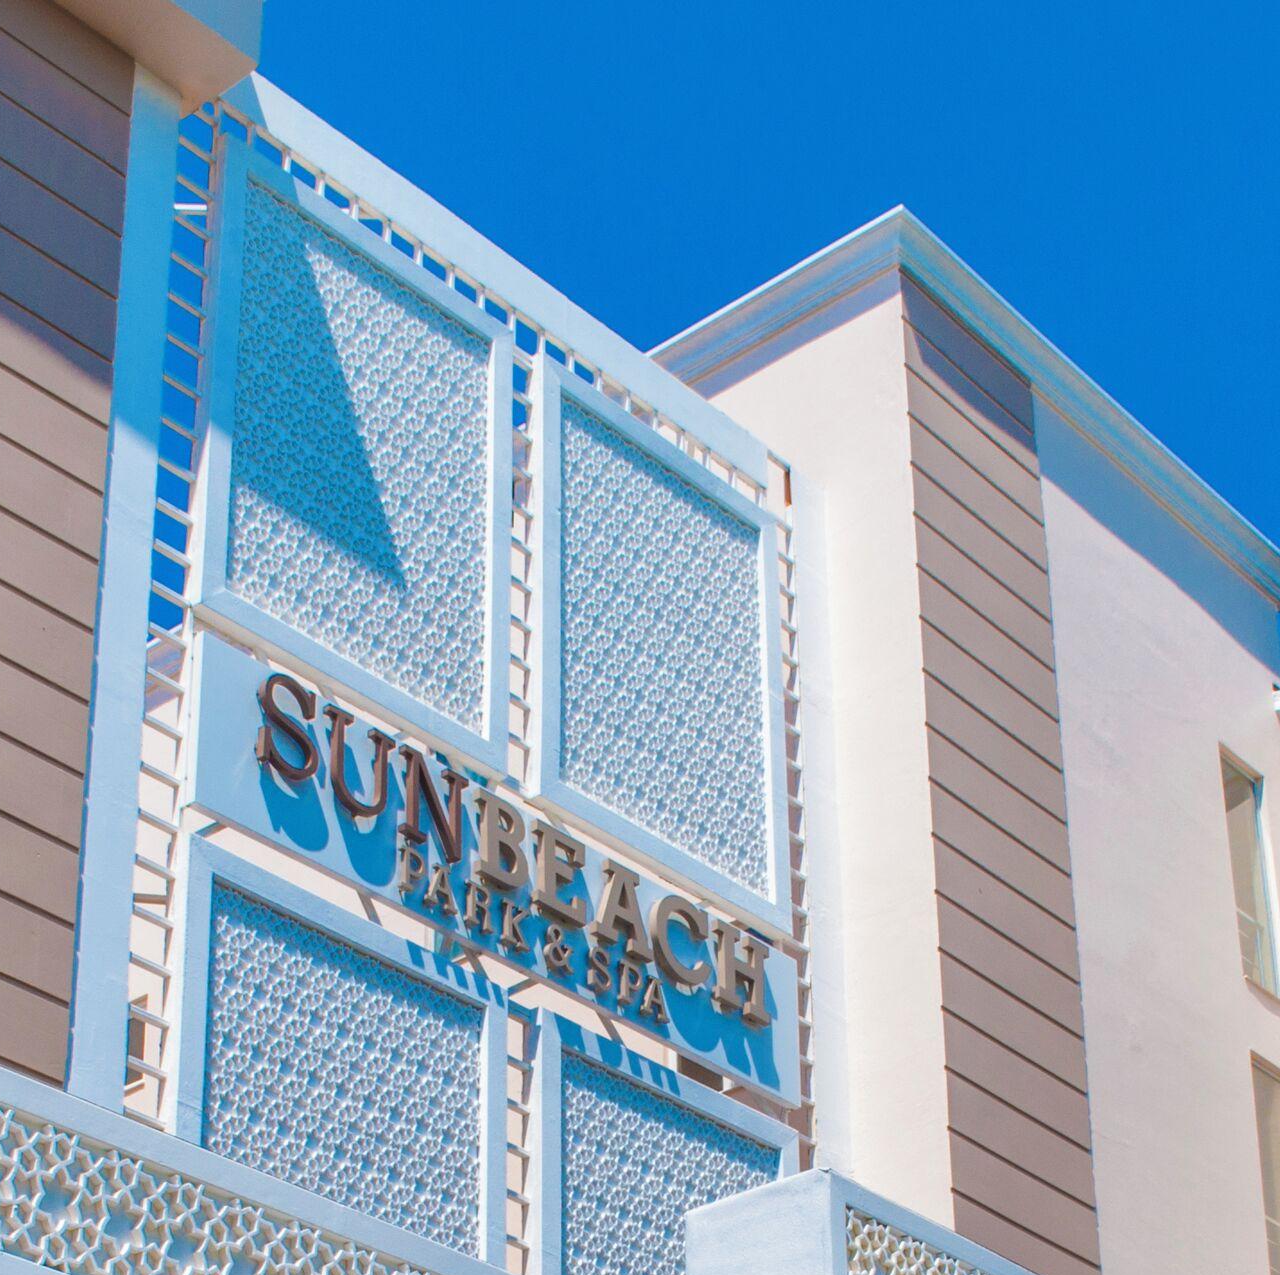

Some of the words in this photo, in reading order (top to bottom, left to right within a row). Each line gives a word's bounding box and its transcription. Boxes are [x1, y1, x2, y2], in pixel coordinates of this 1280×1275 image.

[256, 673, 771, 1028] SUNBEACH
[398, 847, 529, 952] PARK
[543, 924, 572, 974] &
[586, 946, 669, 1024] SPA
